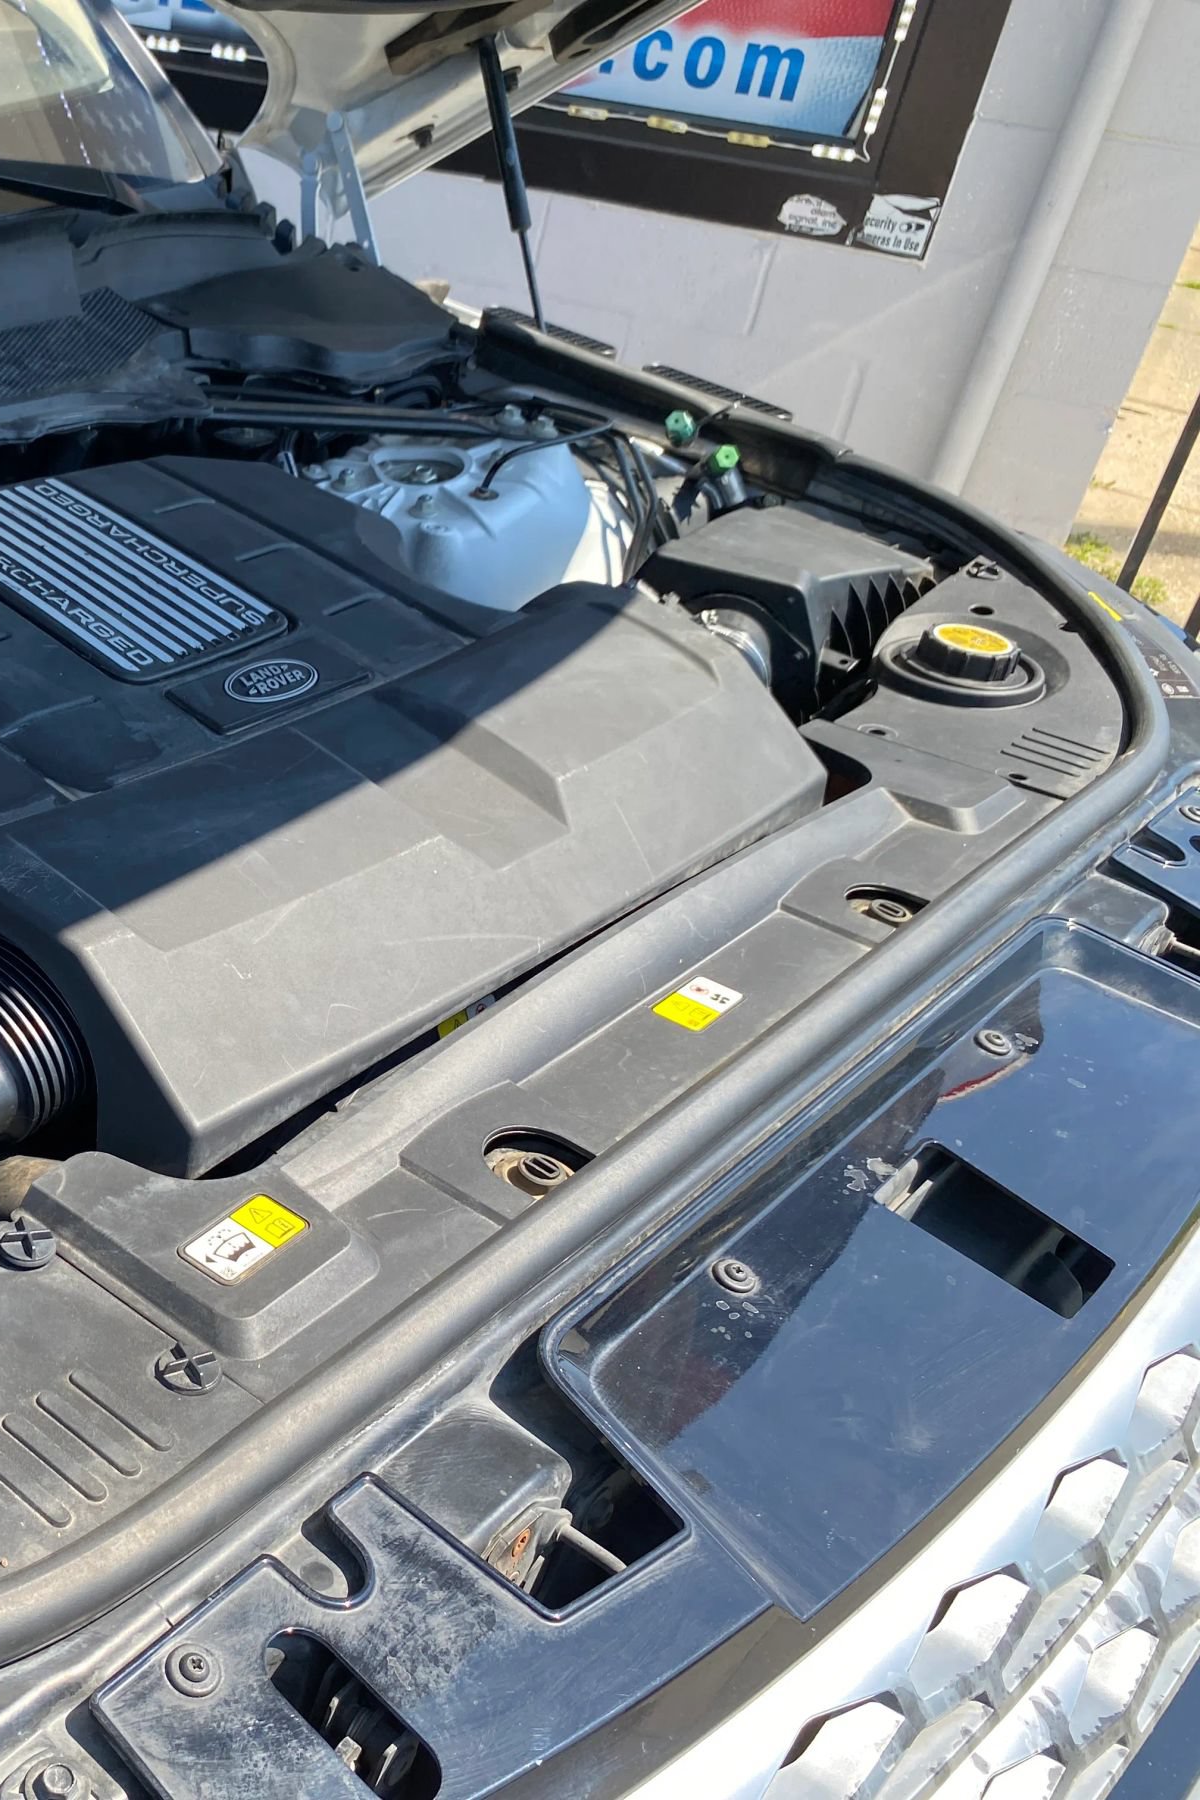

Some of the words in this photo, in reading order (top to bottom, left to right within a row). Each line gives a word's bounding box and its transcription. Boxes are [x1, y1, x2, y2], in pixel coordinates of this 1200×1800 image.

[599, 29, 805, 102] .com
[903, 236, 920, 252] Use
[34, 483, 265, 627] SUPERCHARGED
[239, 664, 282, 687] LAND
[255, 669, 306, 694] ROVER
